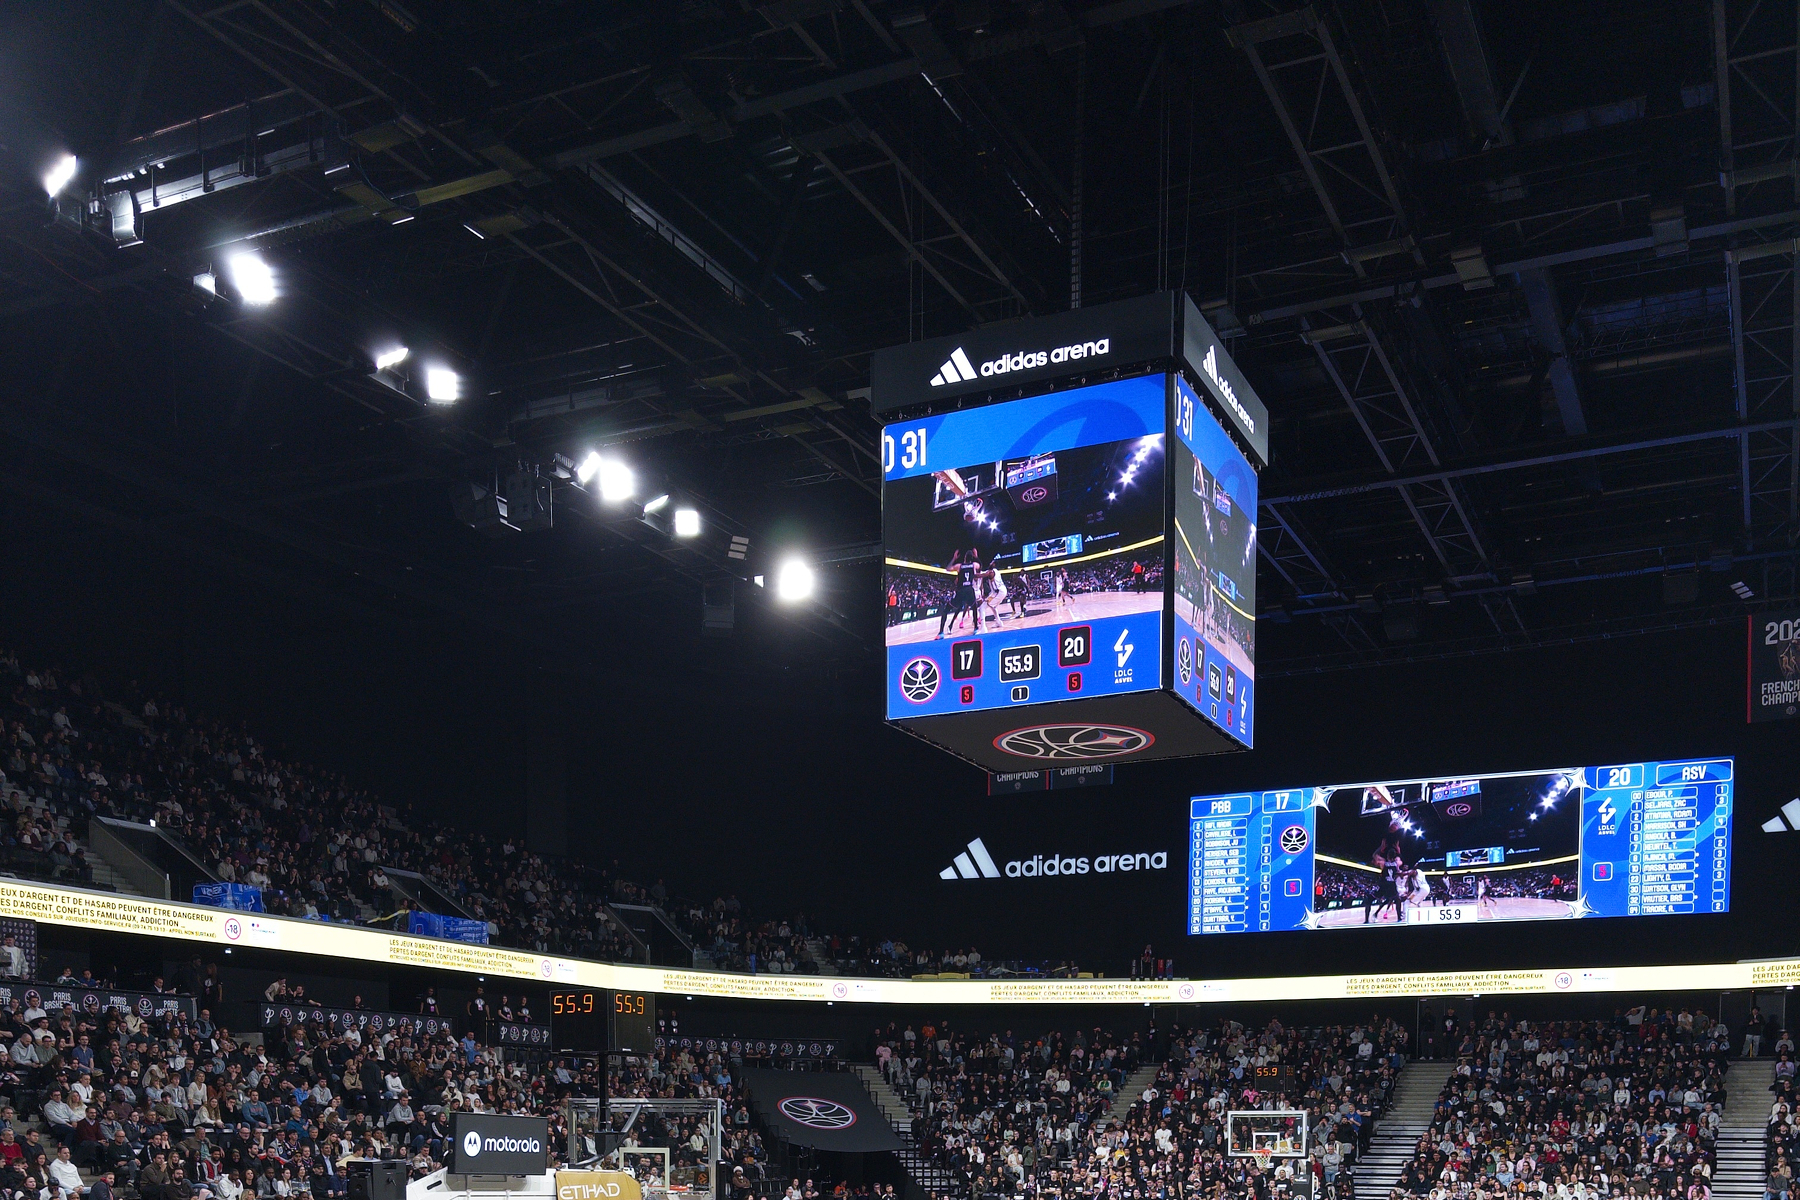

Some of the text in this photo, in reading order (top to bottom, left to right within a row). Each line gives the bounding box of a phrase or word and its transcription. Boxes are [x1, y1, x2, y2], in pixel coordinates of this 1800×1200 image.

[980, 337, 1110, 377] adidas arena
[1218, 376, 1255, 434] adidas arena
[1183, 395, 1193, 441] 31
[902, 428, 927, 469] 31
[1064, 637, 1084, 658] 20
[960, 650, 974, 671] 17
[1004, 655, 1033, 674] 55.9
[1114, 668, 1133, 678] LDLC
[1114, 676, 1133, 684] ASVEL
[1072, 677, 1078, 688] 5
[1762, 680, 1800, 695] FRENCH
[964, 689, 970, 701] 5
[1609, 767, 1631, 787] 20
[1682, 766, 1707, 781] ASV
[1210, 800, 1231, 814] PBB
[1275, 793, 1290, 809] 17
[1005, 851, 1167, 878] adidas arena
[1599, 866, 1607, 877] 5
[1290, 882, 1297, 894] 5
[0, 888, 214, 923] EUX D'ARGENT ET DE HASARD PEUVENT ÊTRE DANGEREUX
[0, 899, 11, 907] ES
[13, 900, 55, 913] D'ARGENT,
[56, 905, 95, 917] CONFLITS
[97, 910, 139, 924] FAMILIAUX,
[140, 916, 179, 927] ADDICTION
[1439, 908, 1461, 921] 55.9
[228, 924, 238, 935] -18
[1557, 977, 1569, 985] -18
[53, 992, 72, 1001] PARIS
[554, 994, 593, 1014] 55.9
[616, 994, 645, 1015] 55.9
[1256, 1067, 1278, 1077] 55.9
[484, 1136, 540, 1153] motorola
[560, 1183, 621, 1200] ETIHAD
